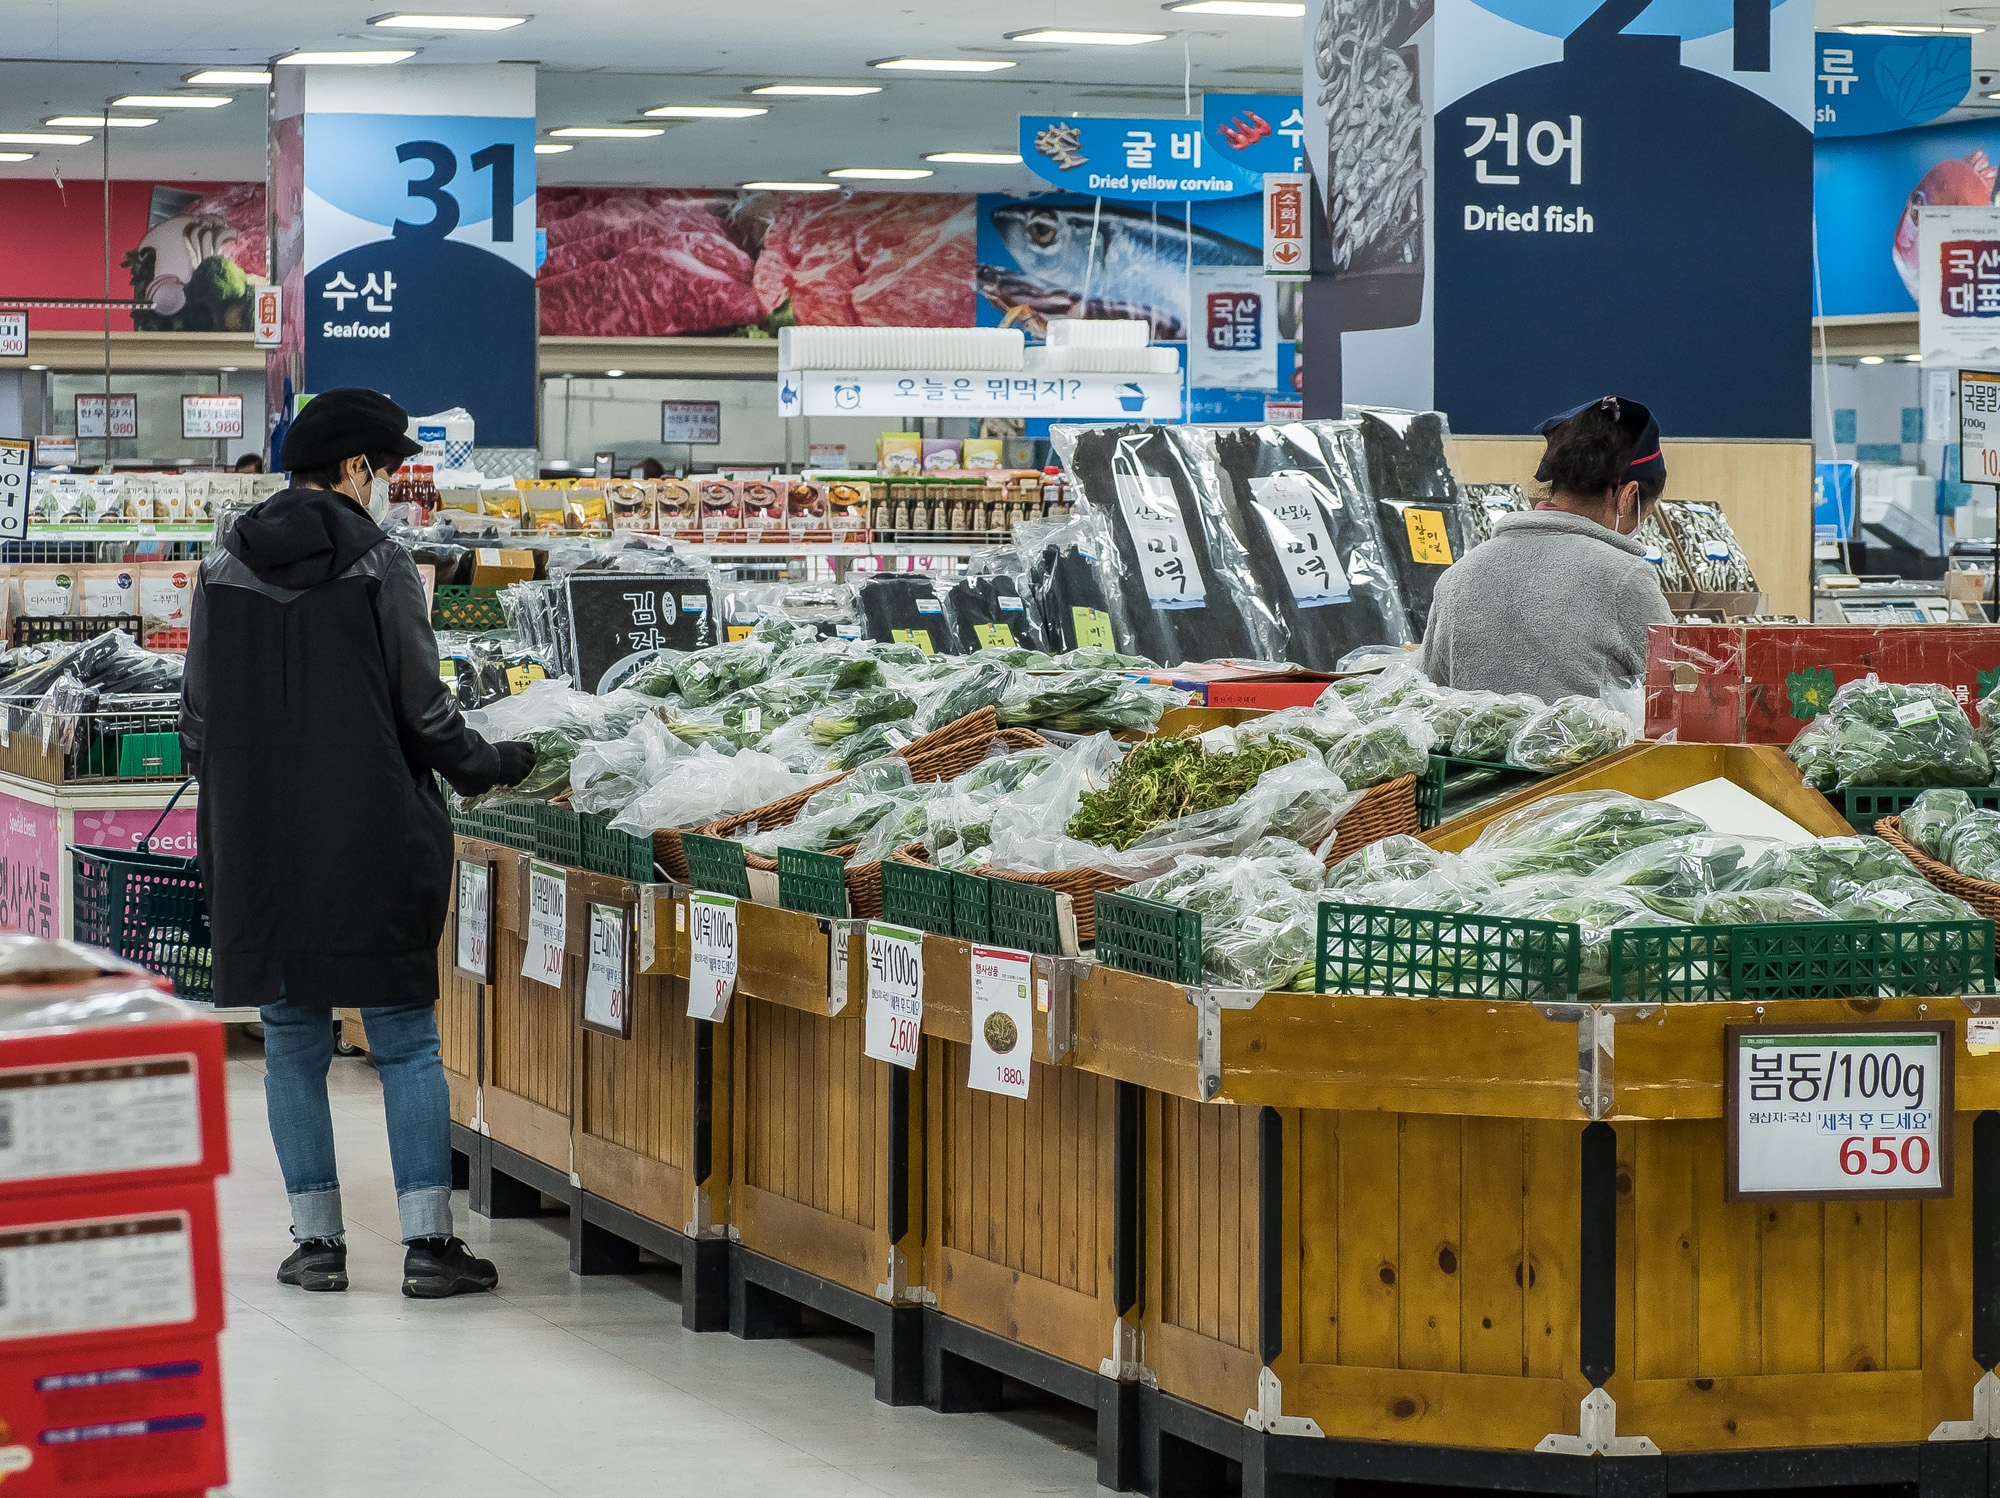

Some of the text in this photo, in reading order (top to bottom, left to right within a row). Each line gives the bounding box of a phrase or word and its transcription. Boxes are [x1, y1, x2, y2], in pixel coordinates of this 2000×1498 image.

[1817, 48, 1859, 95] 류
[1464, 113, 1582, 184] 건어
[393, 139, 516, 241] 31
[1089, 174, 1233, 192] Dried yellow corvina
[1279, 193, 1298, 236] 소화기
[1464, 203, 1594, 233] Dried fish
[1948, 249, 2000, 280] 국산
[322, 271, 397, 313] 수산
[1947, 283, 2000, 313] 대표
[1212, 298, 1257, 323] 국산
[323, 321, 391, 338] Seafood
[1212, 324, 1257, 348] 대표
[894, 377, 1081, 401] 오늘은 뭐먹지?
[1964, 384, 2000, 413] 국물멸
[203, 421, 241, 434] 3,980
[1963, 418, 1985, 430] 700g
[1147, 534, 1187, 595] 미역
[101, 594, 122, 608] 김부각
[693, 906, 733, 959] 아욱/100g
[543, 943, 564, 976] 1,200
[871, 938, 919, 998] 쑥/100g
[975, 962, 999, 977] 행사상품
[889, 1016, 918, 1057] 2,600
[1749, 1051, 1925, 1110] 봄동/100g
[1749, 1112, 1812, 1124] 원산지:국산
[1859, 1113, 1874, 1130] 후
[1838, 1136, 1931, 1176] 650
